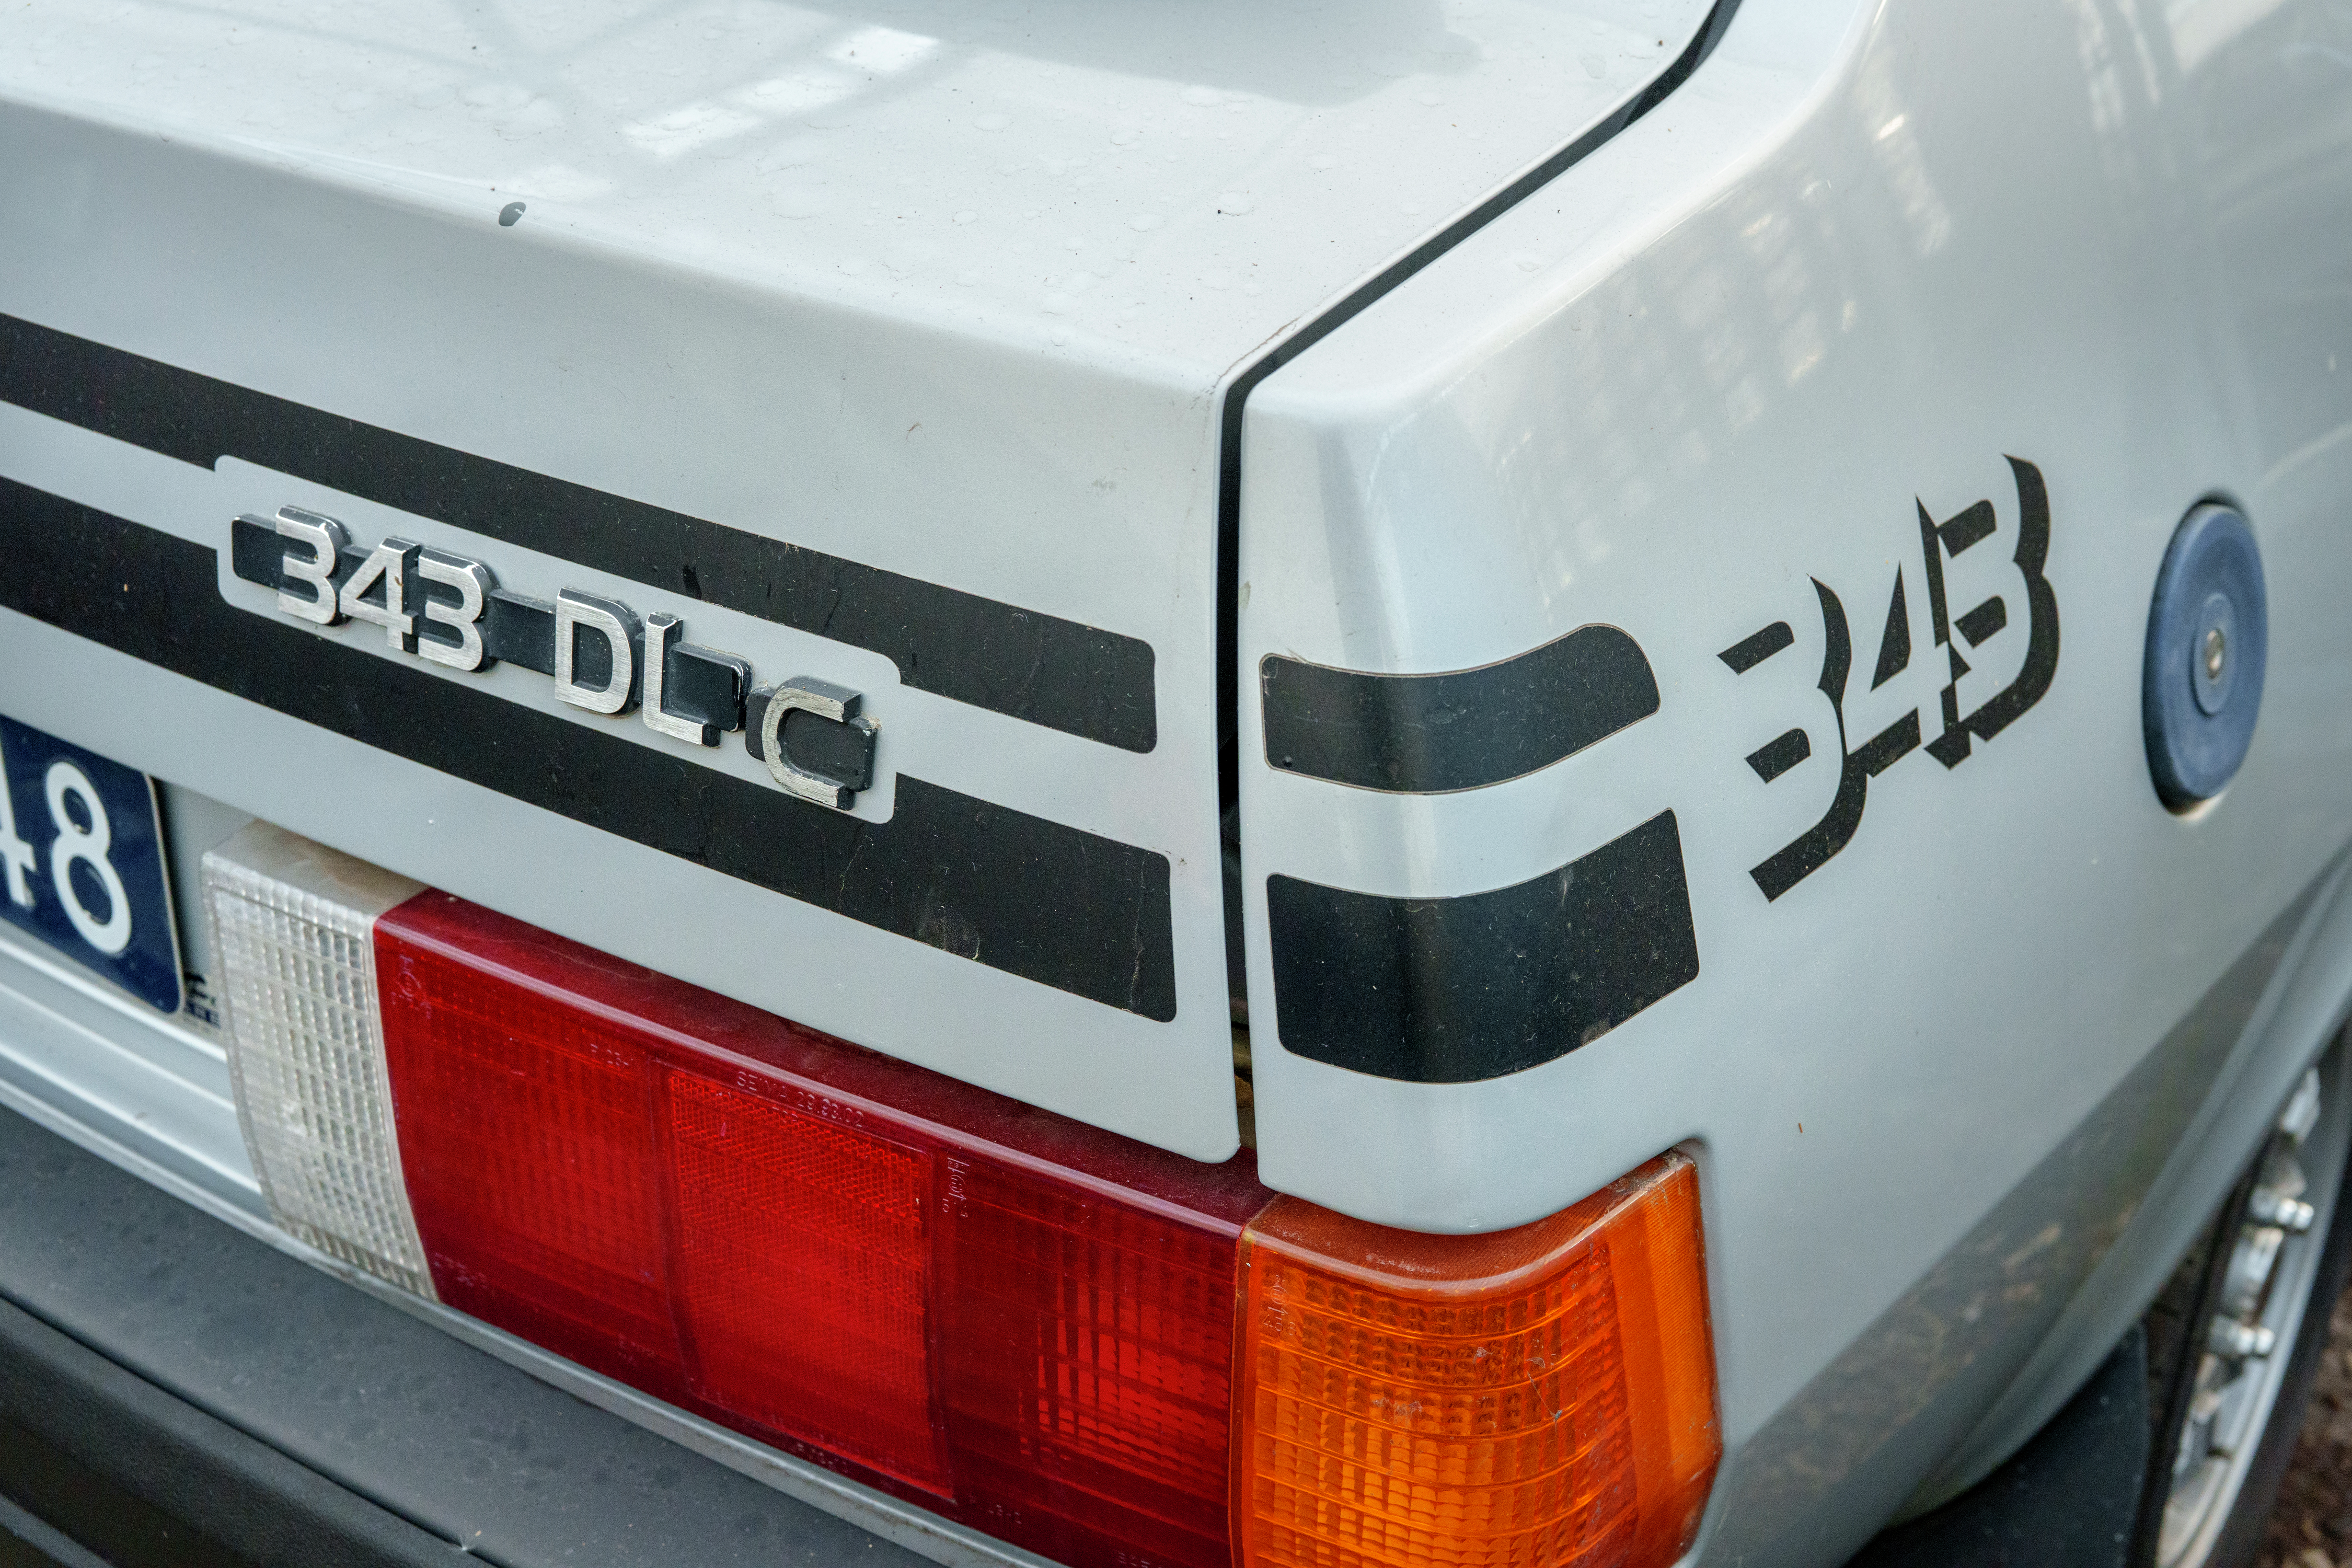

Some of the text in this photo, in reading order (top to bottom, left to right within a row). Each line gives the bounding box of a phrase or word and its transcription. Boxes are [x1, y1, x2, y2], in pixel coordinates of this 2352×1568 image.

[275, 504, 862, 811] 343 DL C
[1716, 454, 2060, 903] 343
